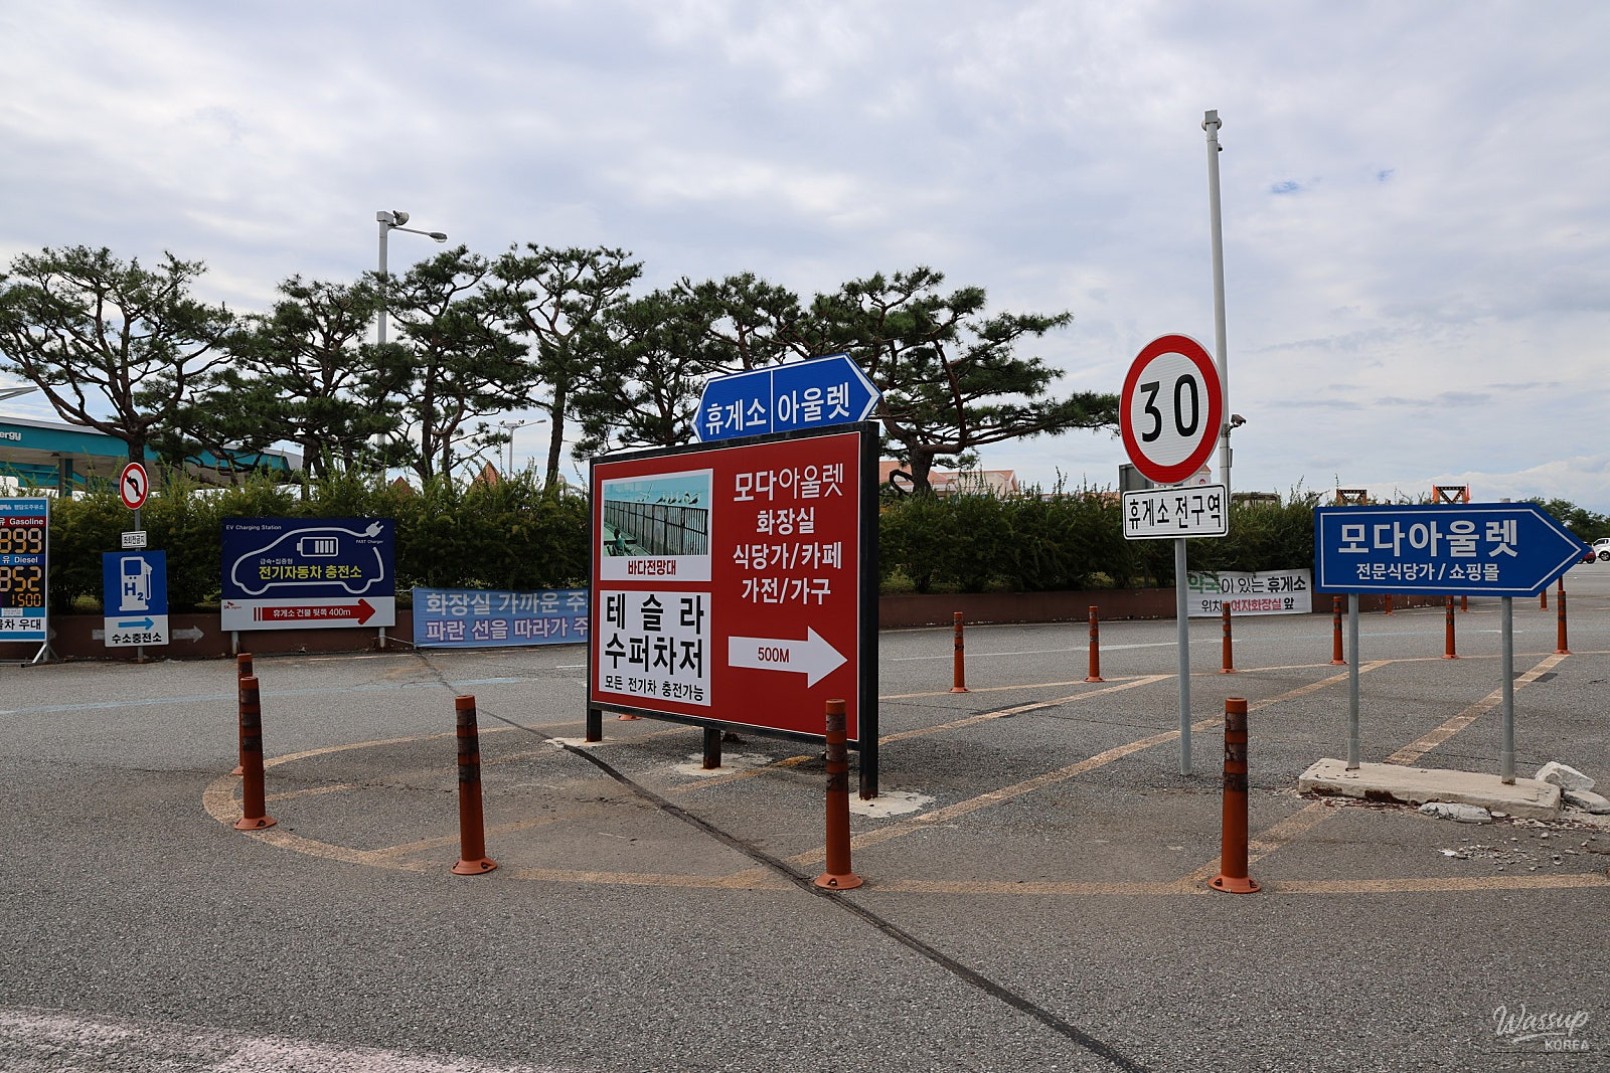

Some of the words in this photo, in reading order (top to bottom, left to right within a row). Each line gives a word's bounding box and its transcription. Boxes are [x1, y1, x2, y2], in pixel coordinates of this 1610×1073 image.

[705, 398, 767, 435] 휴게소
[777, 382, 850, 424] 아울렛
[1140, 373, 1199, 442] 30
[733, 463, 844, 502] 모다아울렛
[756, 507, 815, 536] 화장실
[1129, 498, 1169, 530] 휴게소
[1175, 493, 1221, 529] 전구역
[1338, 519, 1519, 558] 모다아울렛
[627, 559, 677, 576] 바다전망대
[732, 541, 842, 570] 식당가/카페
[259, 565, 322, 580] 전기자동차
[325, 565, 362, 579] 충전소
[1238, 576, 1264, 593] 있는
[1267, 576, 1306, 593] 휴게소
[12, 593, 41, 607] 1500
[741, 577, 831, 605] 가전/가구
[273, 609, 295, 618] 휴게소
[297, 608, 311, 617] 건물
[328, 608, 351, 616] 400m
[426, 592, 491, 616] 화장실
[498, 592, 560, 614] 가까운
[1231, 598, 1281, 612] 여자화장실
[1284, 597, 1294, 610] 앞
[19, 619, 41, 630] 우대
[426, 620, 465, 641] 파란
[471, 619, 508, 640] 선을
[514, 617, 568, 638] 따라가
[112, 632, 162, 644] 수소충전소
[605, 632, 703, 678] 수퍼차저
[757, 647, 790, 663] 500M
[605, 675, 623, 690] 모든
[628, 677, 657, 695] 전기차
[661, 681, 704, 701] 충전가능
